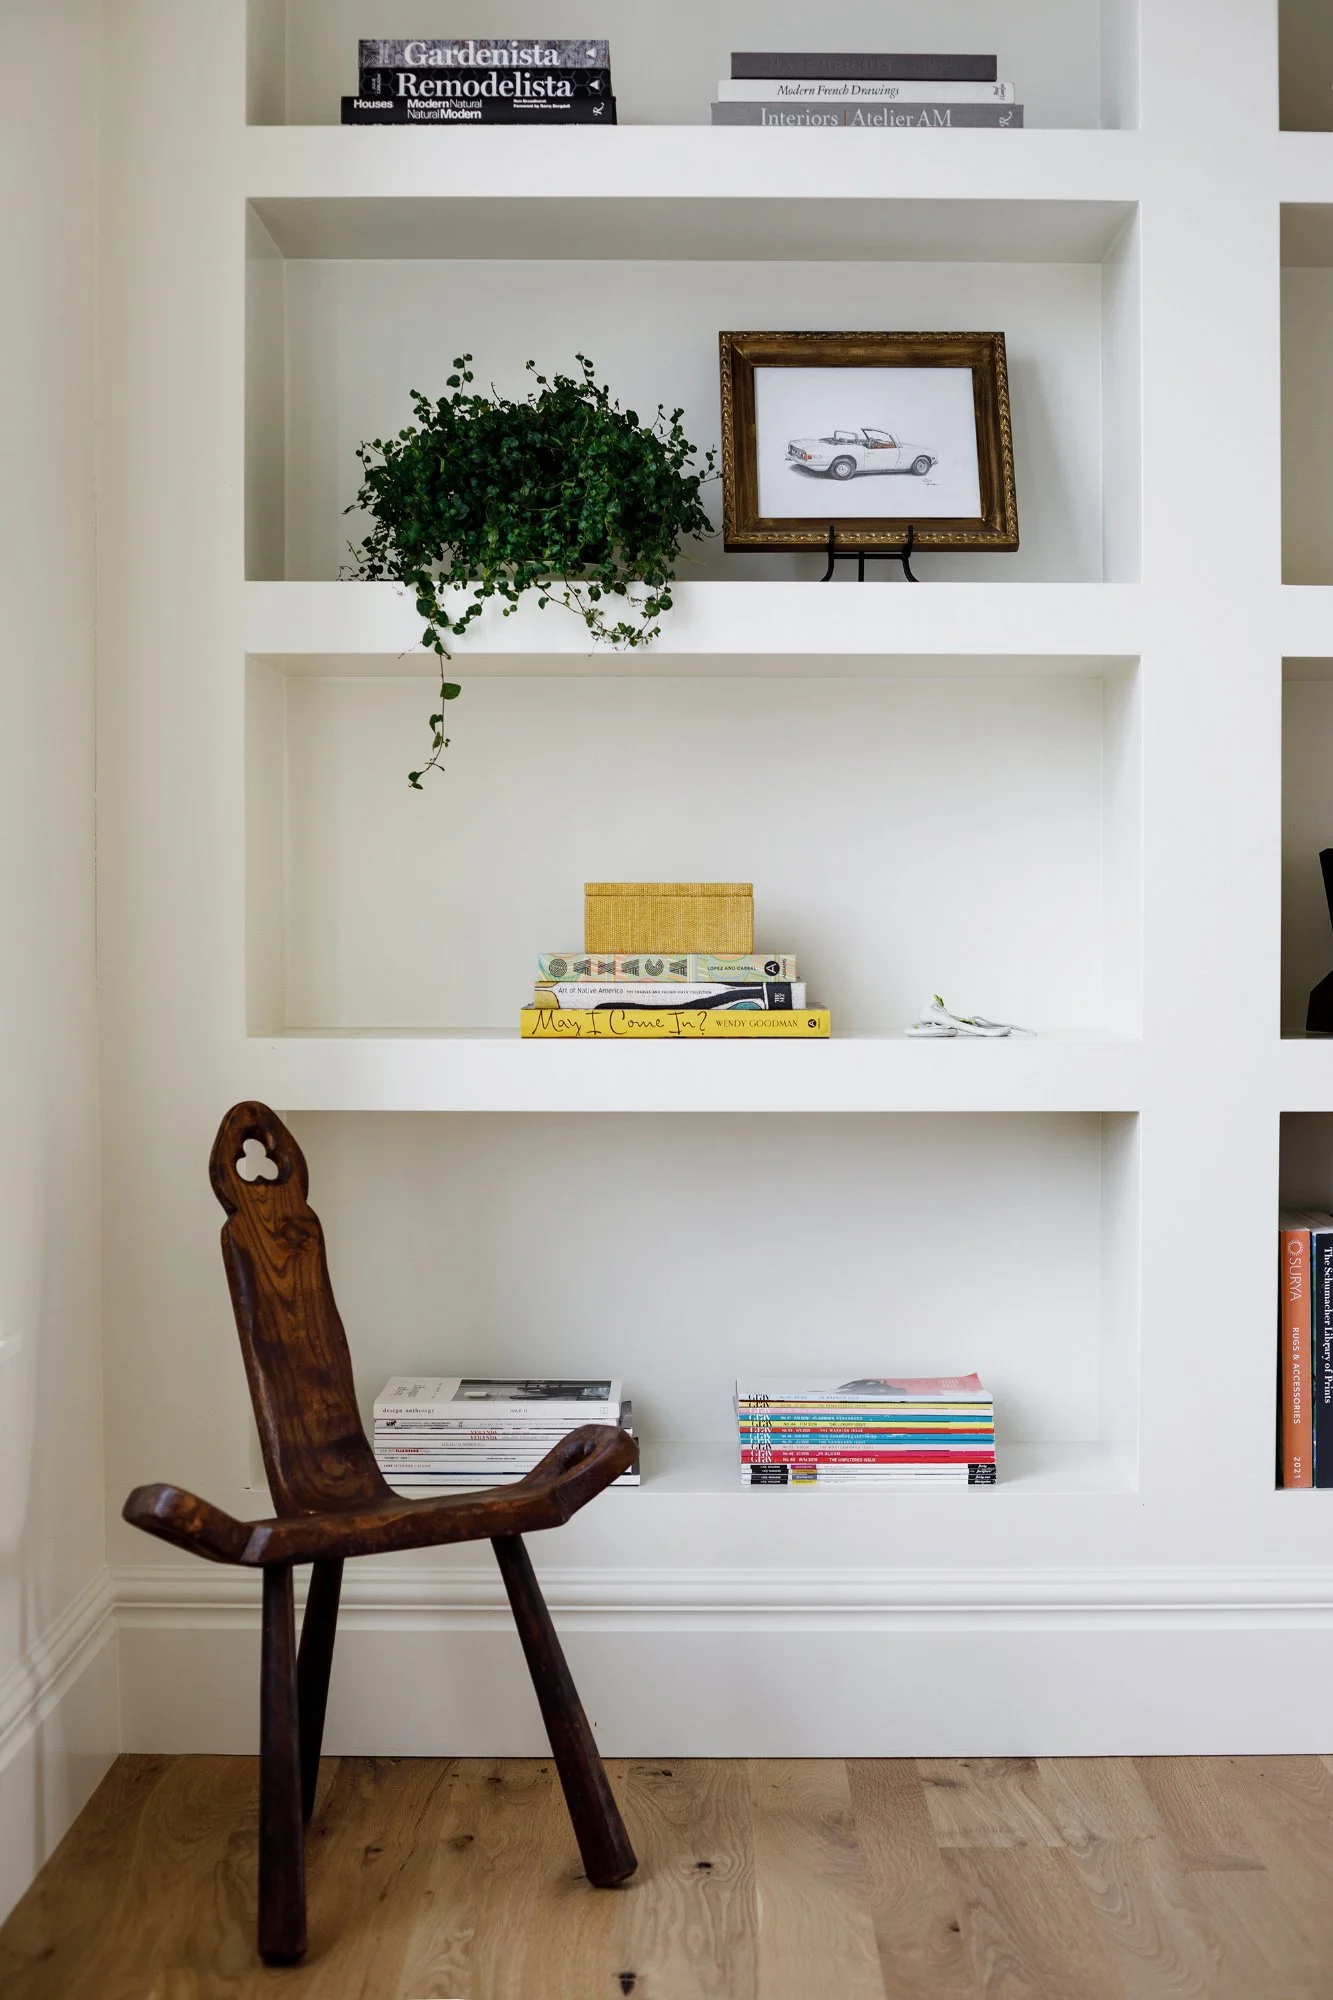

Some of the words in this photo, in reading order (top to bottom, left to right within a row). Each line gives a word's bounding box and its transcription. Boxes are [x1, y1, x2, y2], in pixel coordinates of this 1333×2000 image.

[404, 41, 561, 66] Gardenista
[396, 71, 574, 97] Remodelista
[777, 84, 815, 96] Modern
[817, 84, 849, 96] French
[851, 84, 900, 98] Drawings
[353, 99, 394, 108] Houses
[407, 99, 450, 108] Modern
[450, 99, 482, 108] Natural
[407, 109, 440, 118] Natural
[440, 109, 482, 118] Modern
[760, 108, 838, 126] Interiors
[850, 108, 915, 126] Atelier
[918, 108, 952, 126] AM
[532, 1010, 582, 1036] May
[587, 1012, 602, 1034] I
[609, 1010, 664, 1035] Come
[668, 1010, 708, 1036] In?
[715, 1019, 746, 1028] WENDY
[750, 1019, 798, 1028] GOODMAN
[1324, 1247, 1332, 1265] The
[1289, 1258, 1302, 1301] SURYA
[1324, 1267, 1333, 1325] Schumacher
[1322, 1327, 1333, 1360] Library
[1324, 1363, 1333, 1372] of
[1324, 1376, 1333, 1404] Prints
